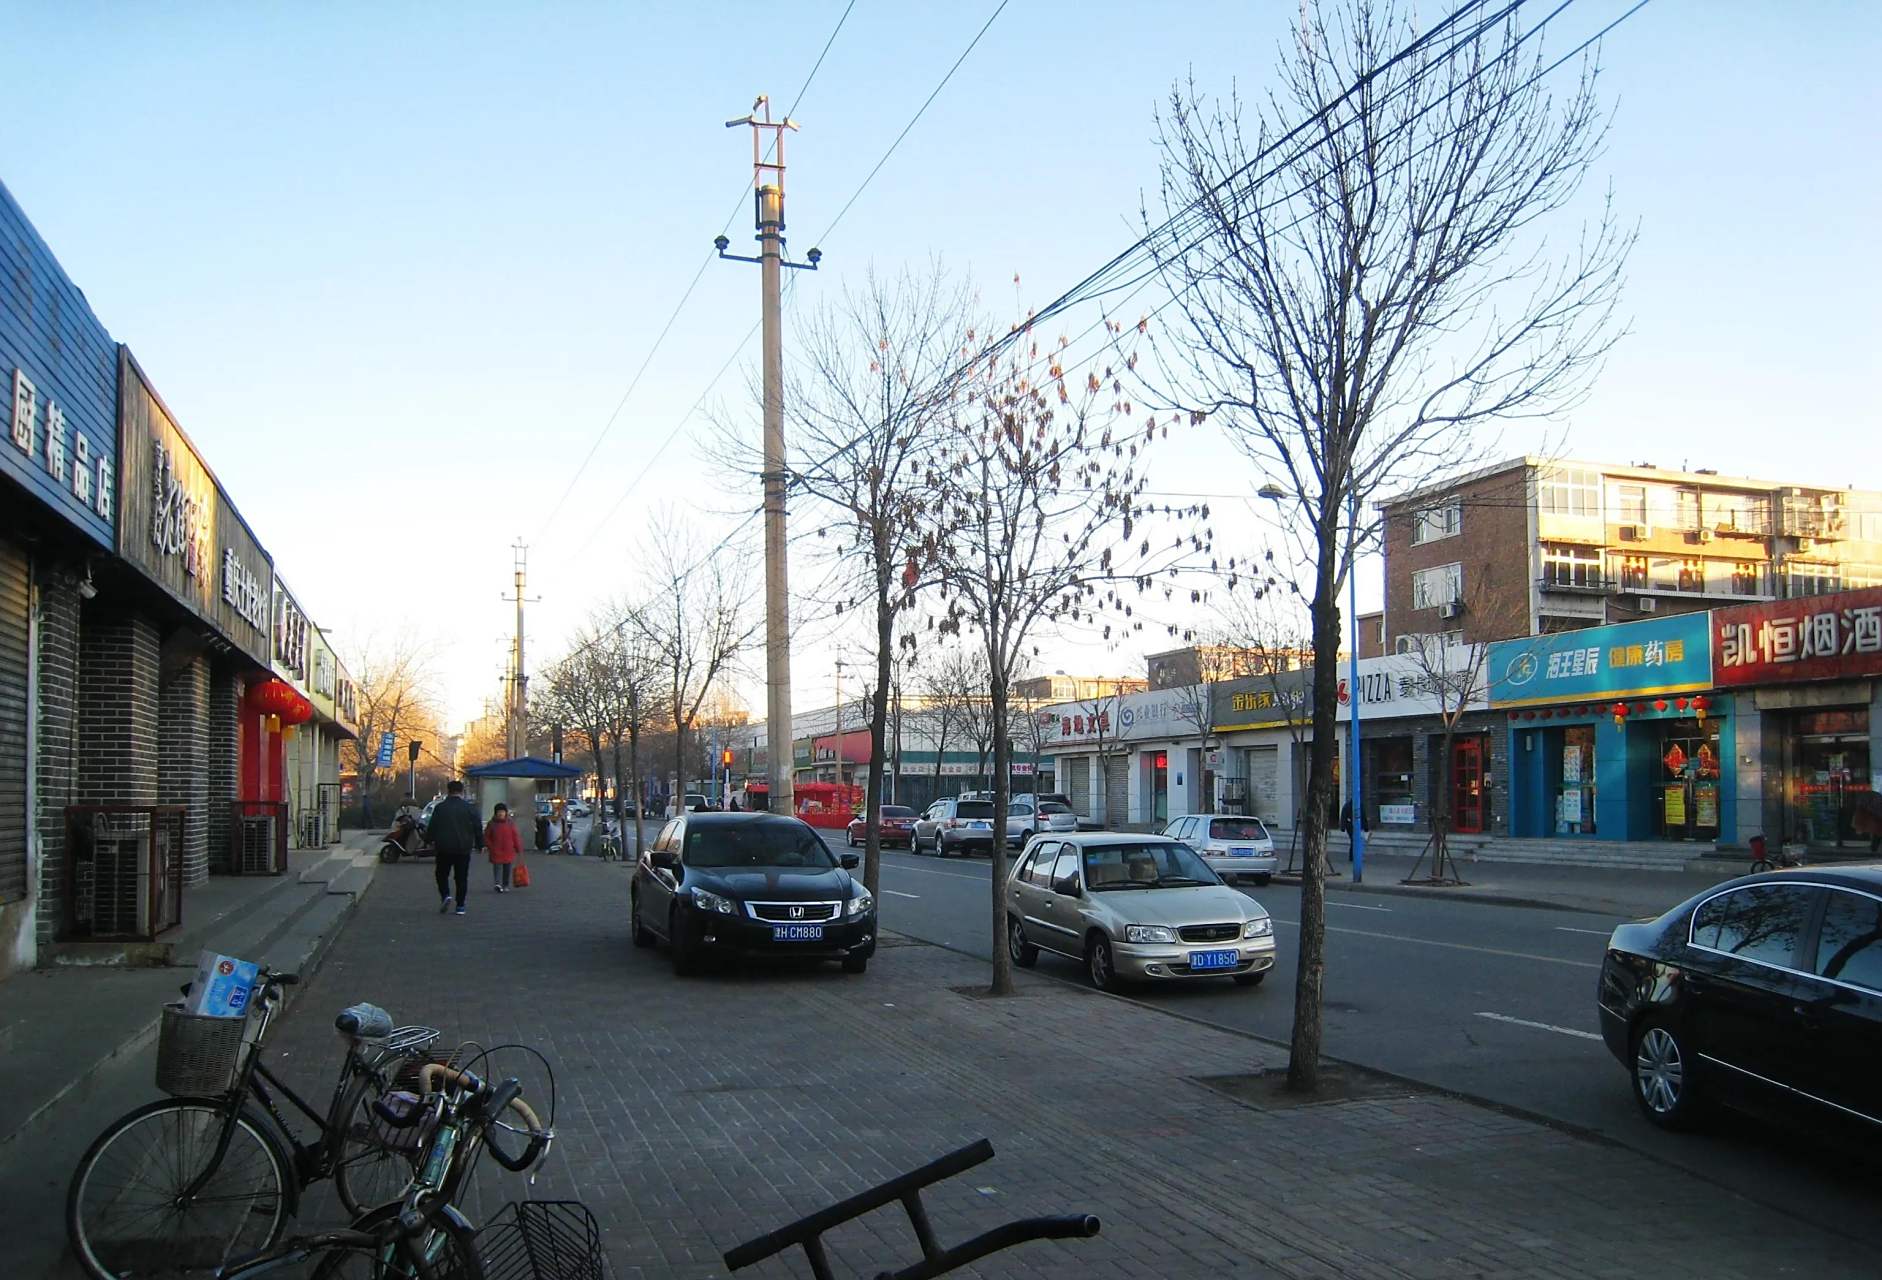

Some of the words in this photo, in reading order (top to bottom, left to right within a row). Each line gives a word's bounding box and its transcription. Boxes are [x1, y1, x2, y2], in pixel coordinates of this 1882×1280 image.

[1546, 647, 1600, 679] 海王星辰
[1609, 639, 1685, 668] 健康药房
[1721, 606, 1882, 668] 凯恒烟酒
